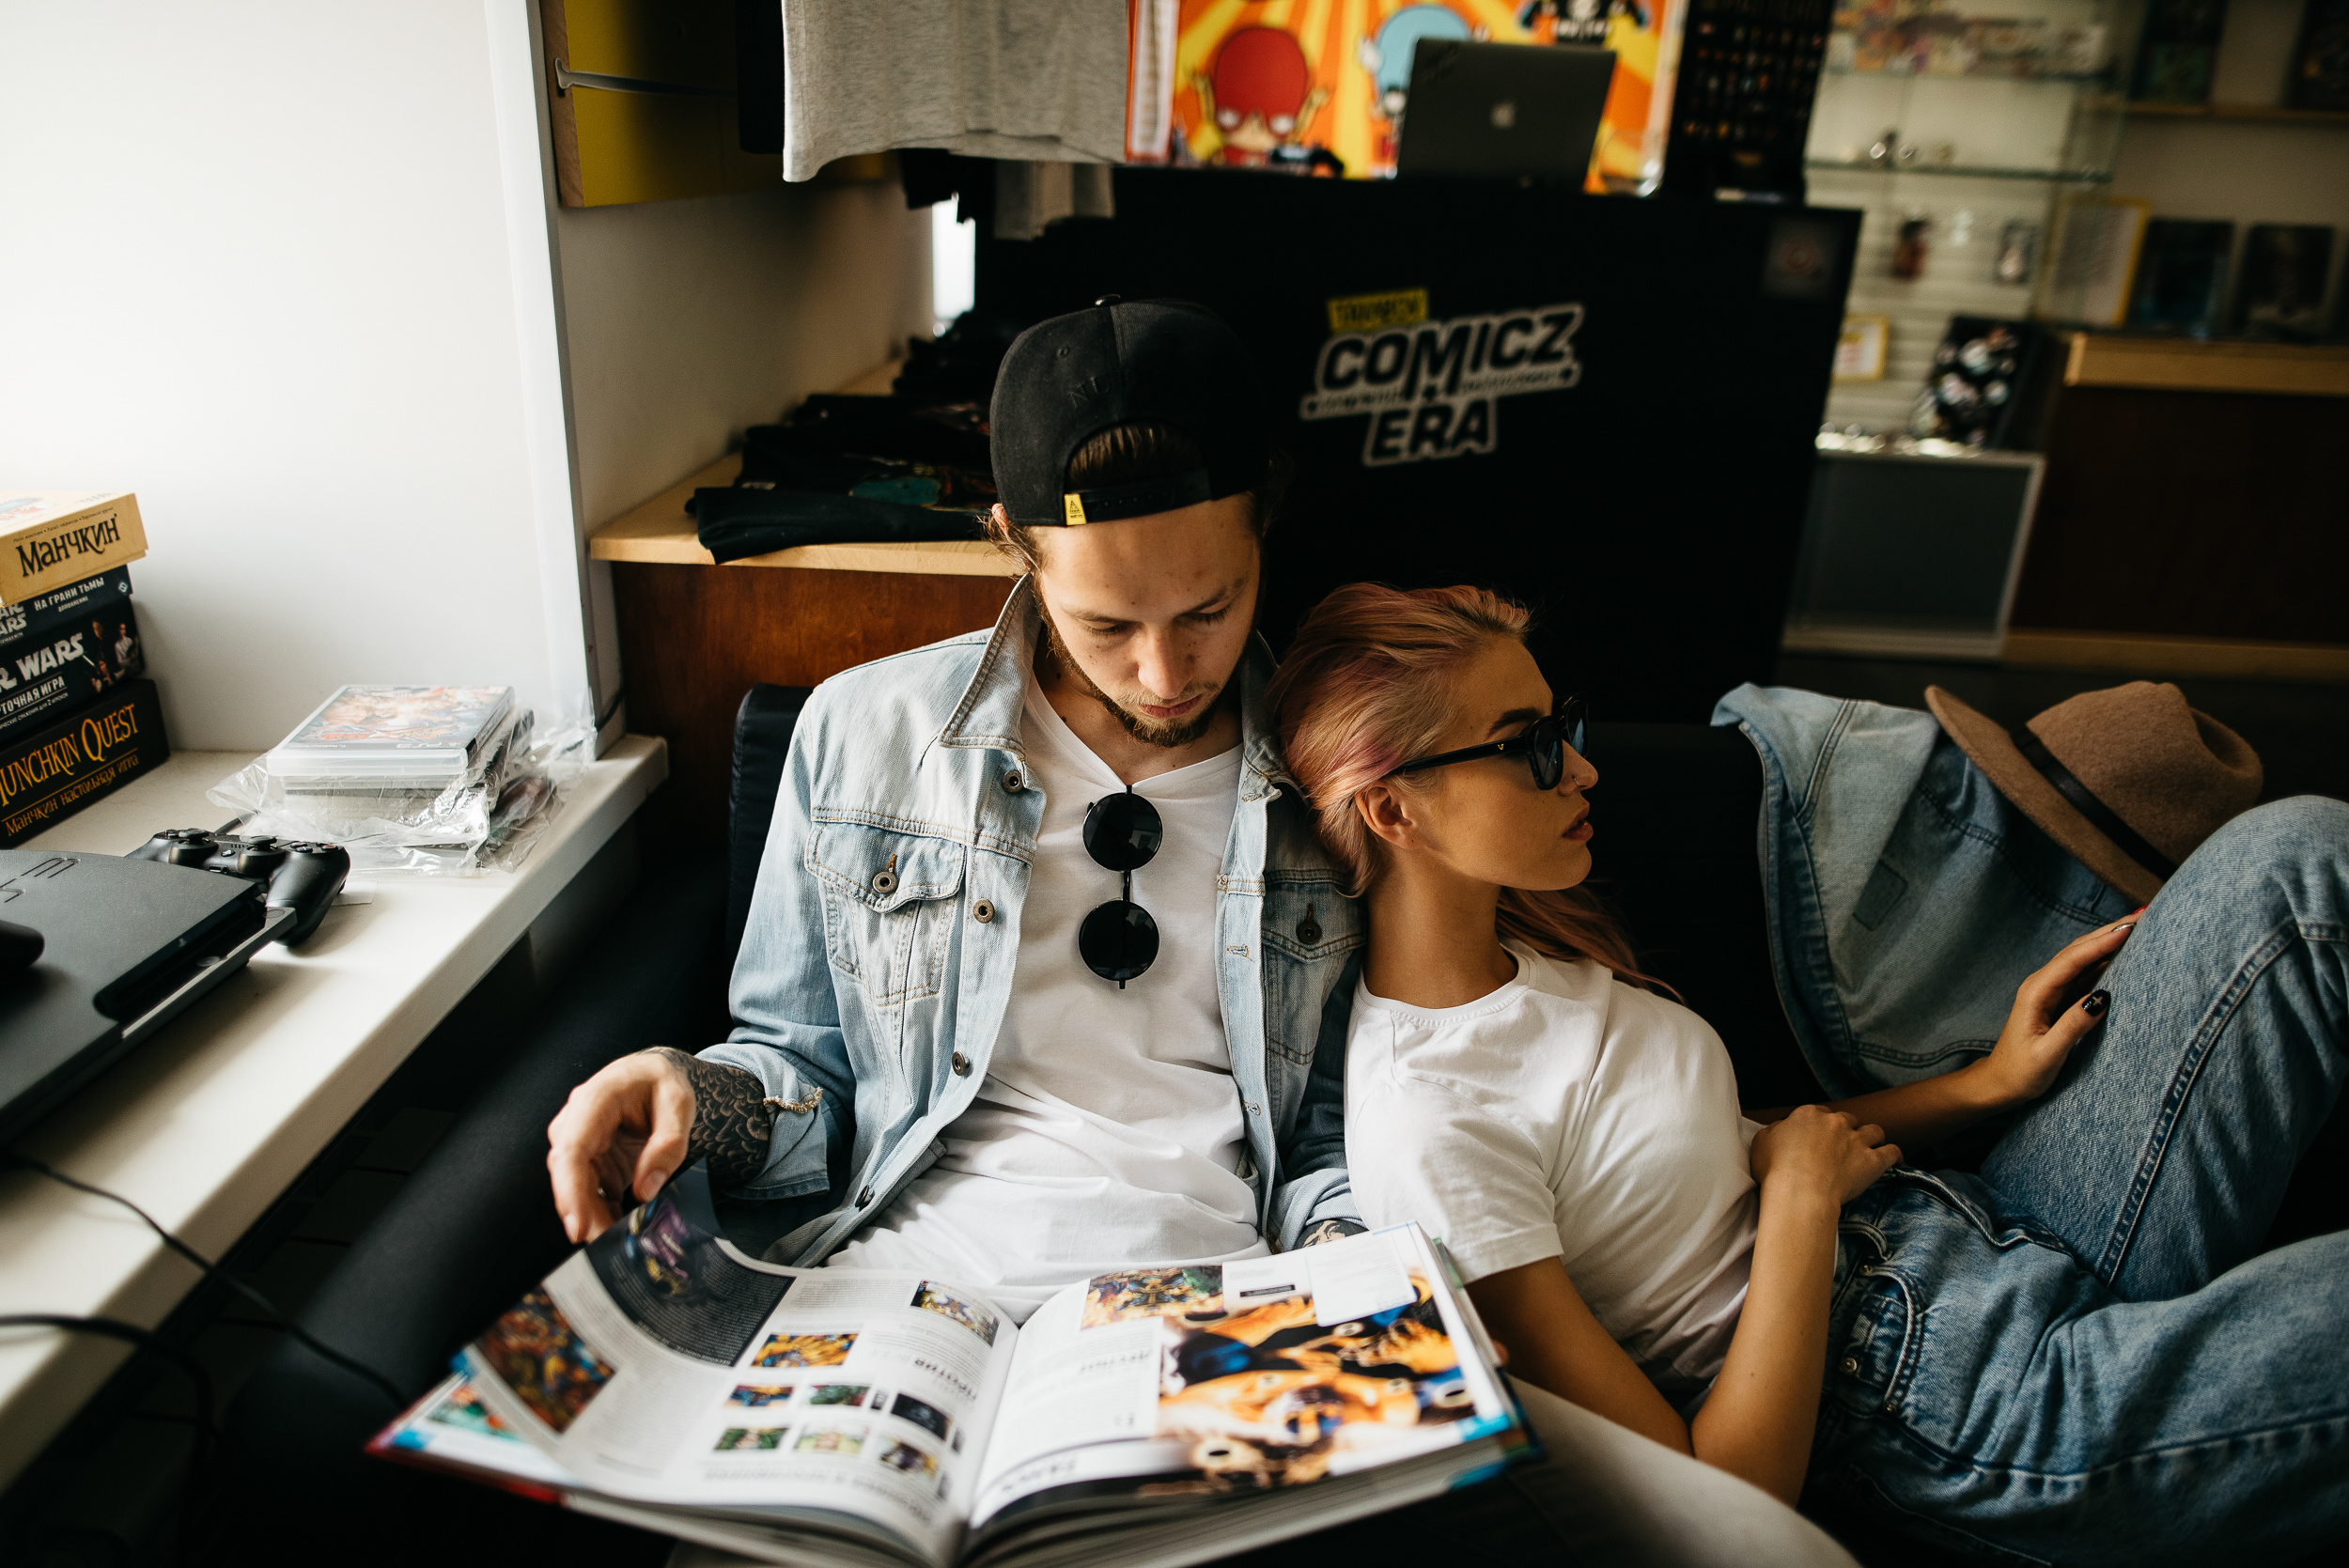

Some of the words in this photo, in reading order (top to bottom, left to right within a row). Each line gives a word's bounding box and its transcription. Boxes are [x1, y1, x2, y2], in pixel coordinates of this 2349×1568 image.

[1321, 310, 1577, 402] COMICZ
[1369, 398, 1490, 460] ERA
[34, 599, 48, 611] НА
[48, 587, 78, 606] ГРАНИ
[78, 577, 105, 594] ТЬМЫ
[16, 632, 85, 681] WARS
[0, 688, 40, 714] ТОЧНАЯ
[39, 675, 66, 696] ИГРА
